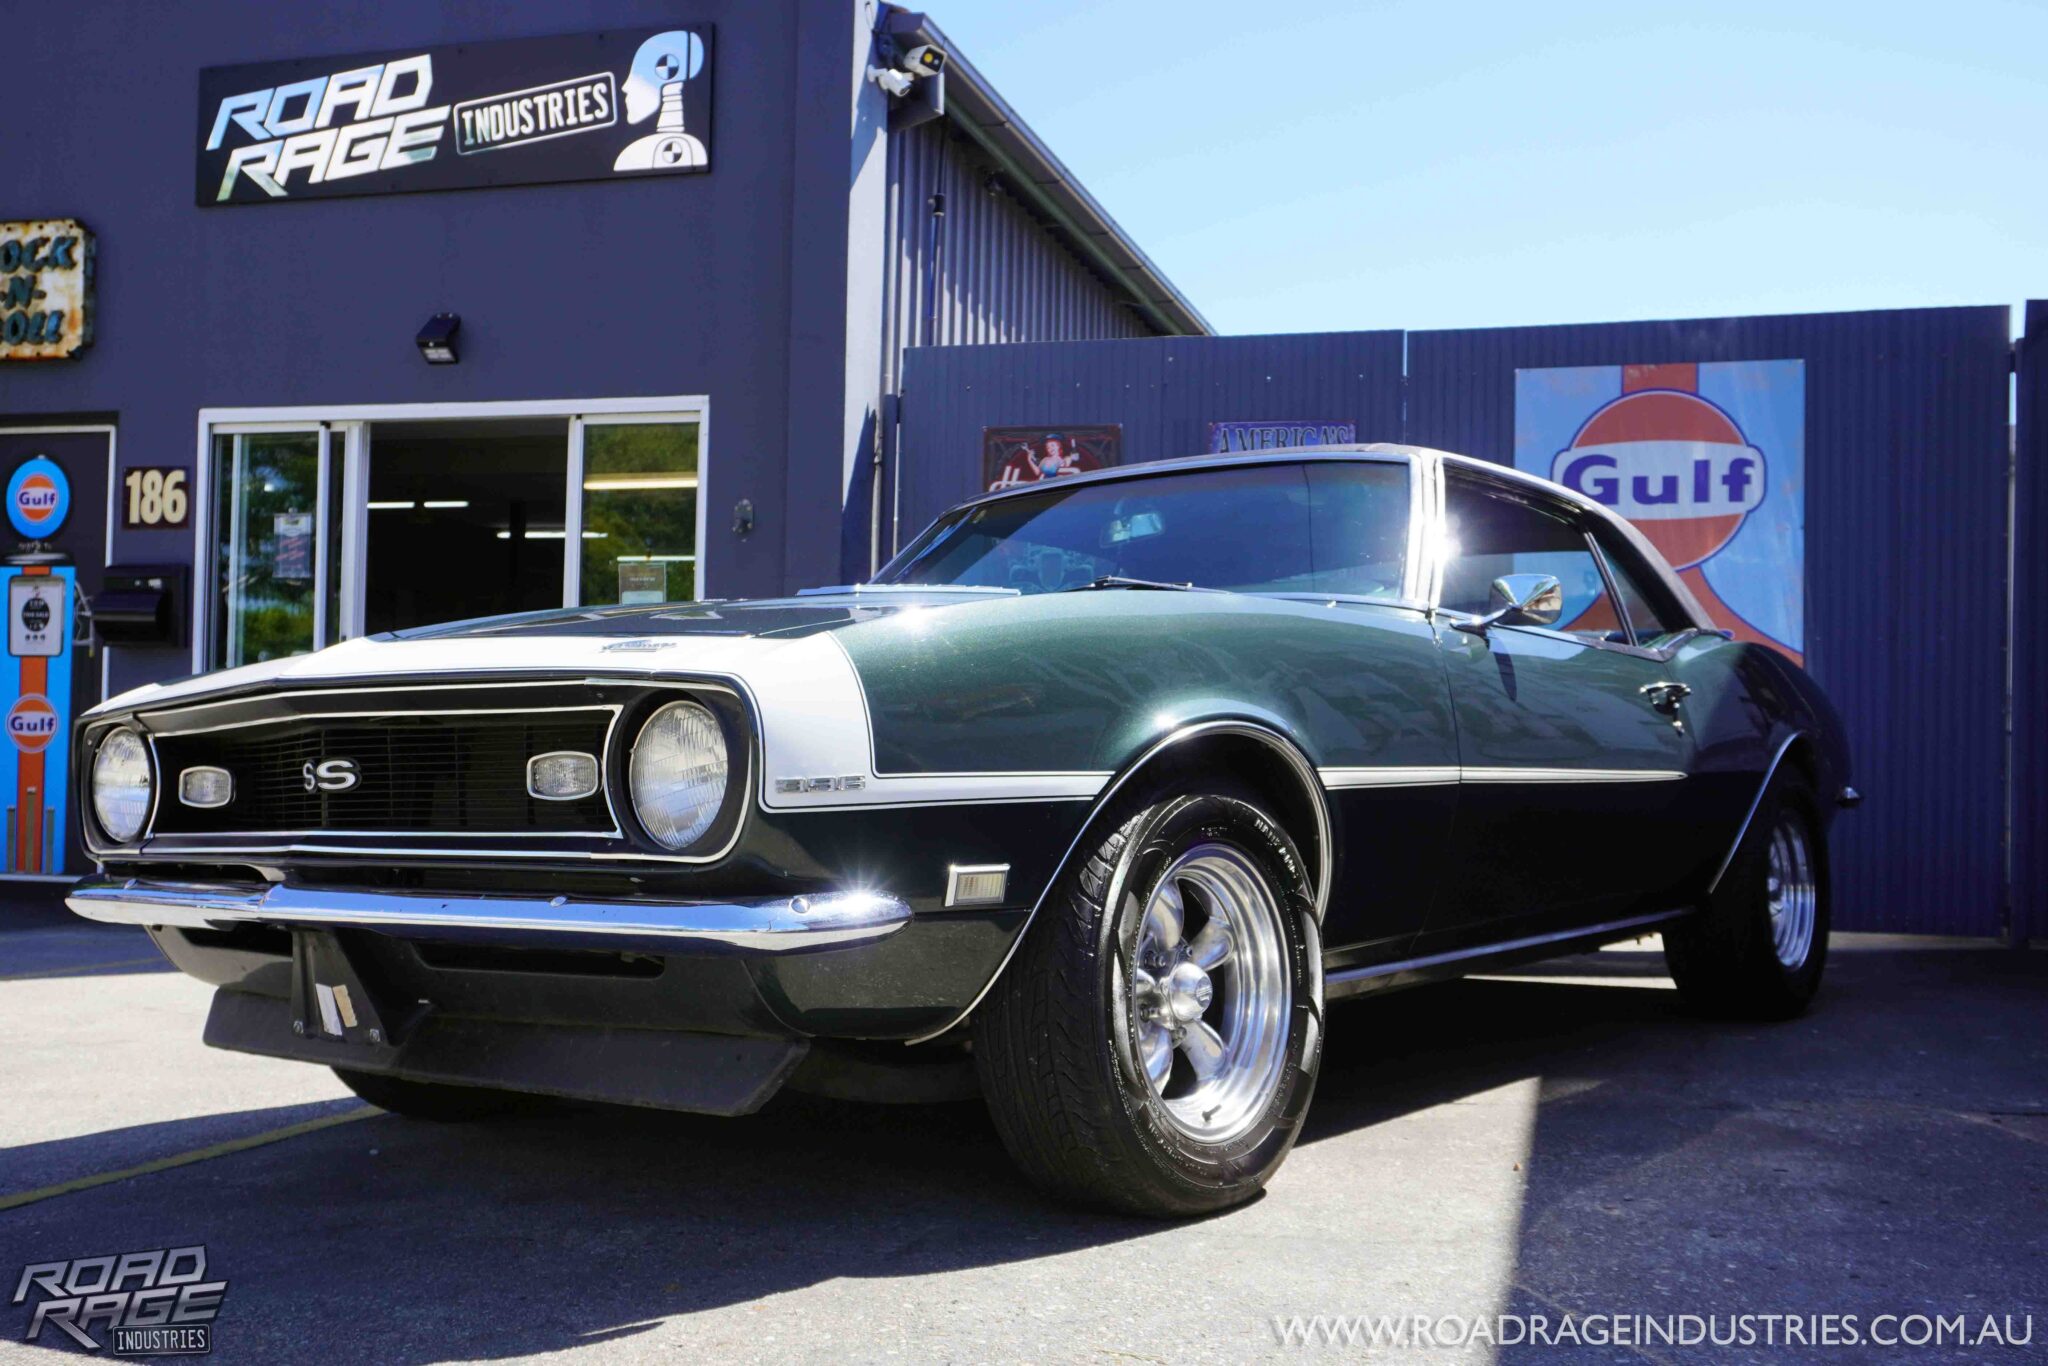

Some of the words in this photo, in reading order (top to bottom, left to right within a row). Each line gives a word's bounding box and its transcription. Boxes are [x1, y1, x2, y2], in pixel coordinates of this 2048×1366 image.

[206, 53, 433, 151] ROAD
[461, 82, 610, 146] INDUSTRIES
[216, 104, 451, 201] RAGE
[0, 236, 78, 273] OCK
[0, 310, 65, 346] OLL
[1218, 426, 1349, 454] AMERICA'S
[125, 469, 188, 525] 186
[1561, 453, 1755, 505] Gulf
[18, 491, 56, 506] Gulf
[10, 715, 55, 732] Gulf
[302, 760, 356, 790] SS
